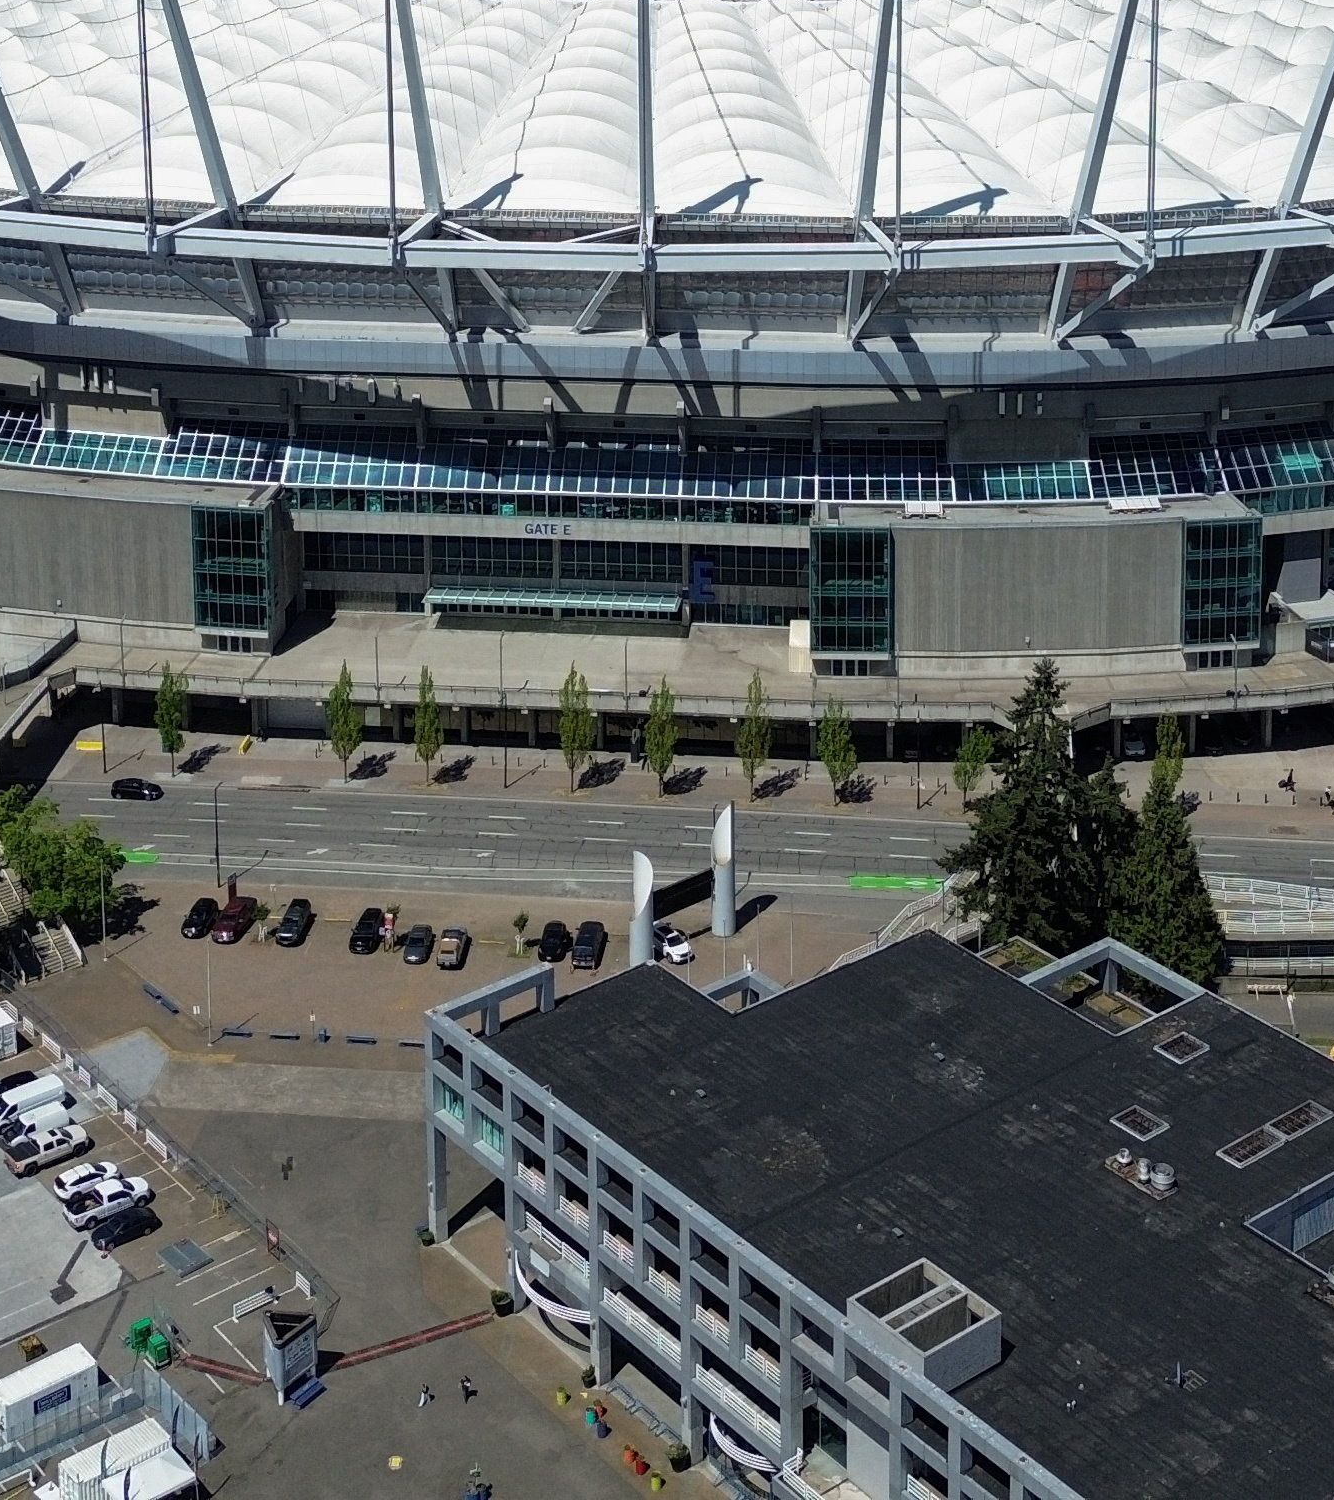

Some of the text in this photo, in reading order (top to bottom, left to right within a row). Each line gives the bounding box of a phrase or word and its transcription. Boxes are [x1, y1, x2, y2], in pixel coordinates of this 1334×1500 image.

[524, 523, 572, 536] GATE E
[692, 560, 716, 603] E
